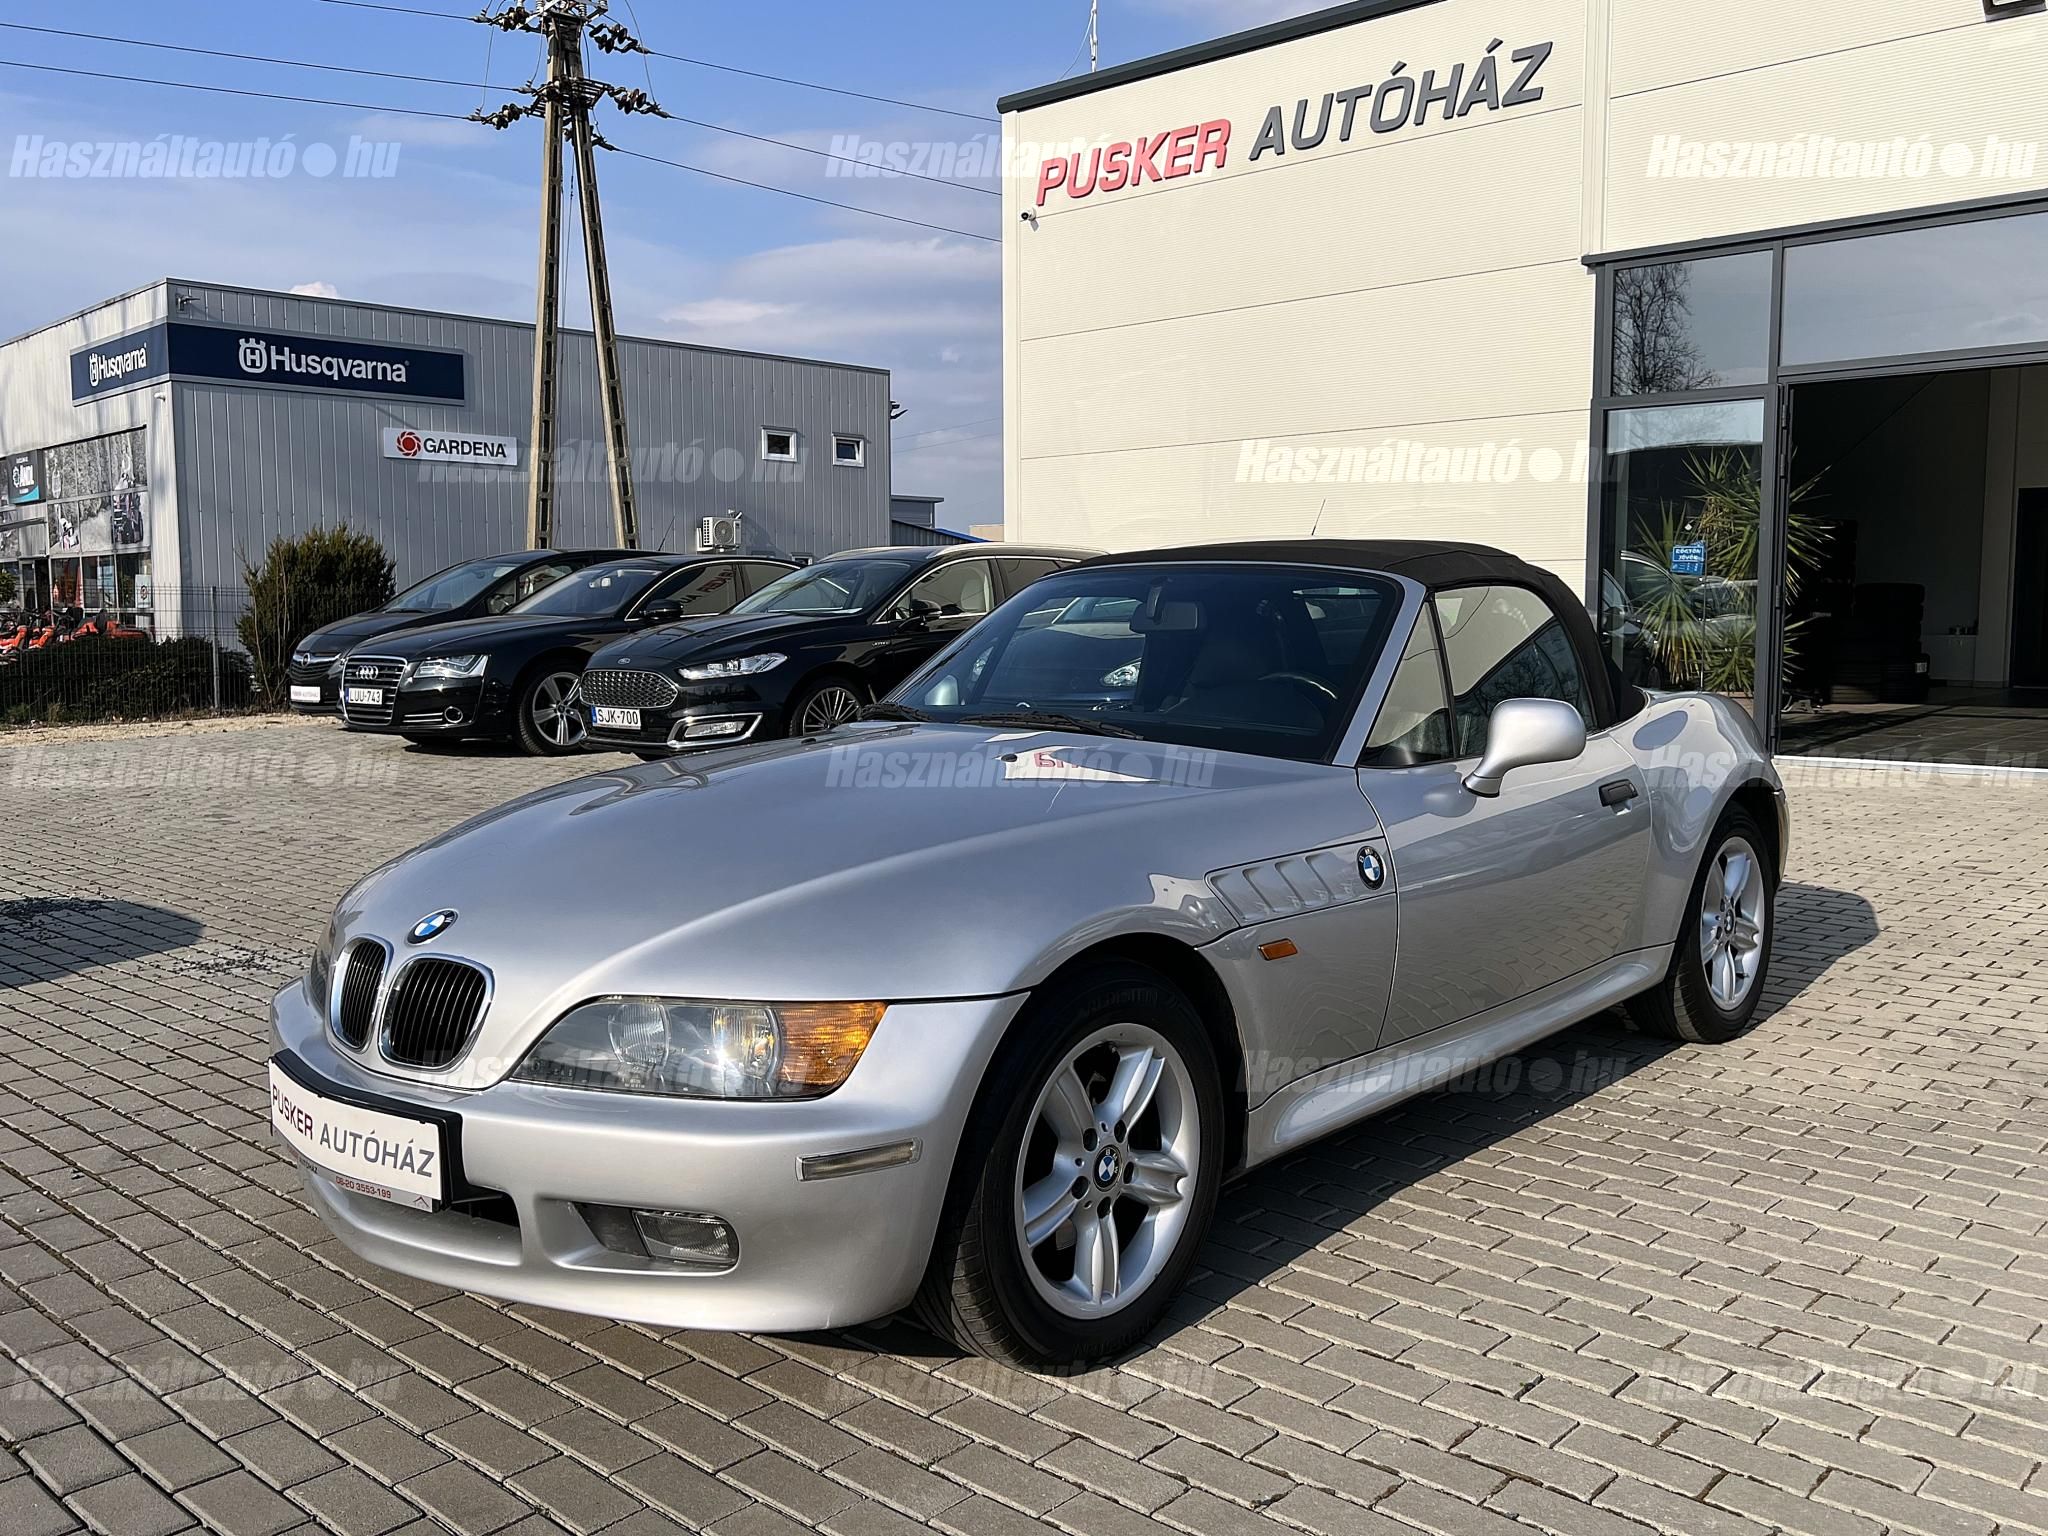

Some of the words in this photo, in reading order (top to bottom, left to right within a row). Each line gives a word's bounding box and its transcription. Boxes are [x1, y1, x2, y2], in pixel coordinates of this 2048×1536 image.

[1036, 118, 1232, 206] PUSKER
[1249, 38, 1553, 161] AUTÓHÁZ
[99, 347, 146, 379] Husqvarna
[270, 345, 406, 383] Husqvarna
[423, 437, 507, 458] GARDENA
[349, 689, 381, 704] LUU-743
[597, 708, 639, 725] SJK-700
[272, 1083, 314, 1141] PUSKER
[319, 1122, 435, 1178] AUTÓHÁZ
